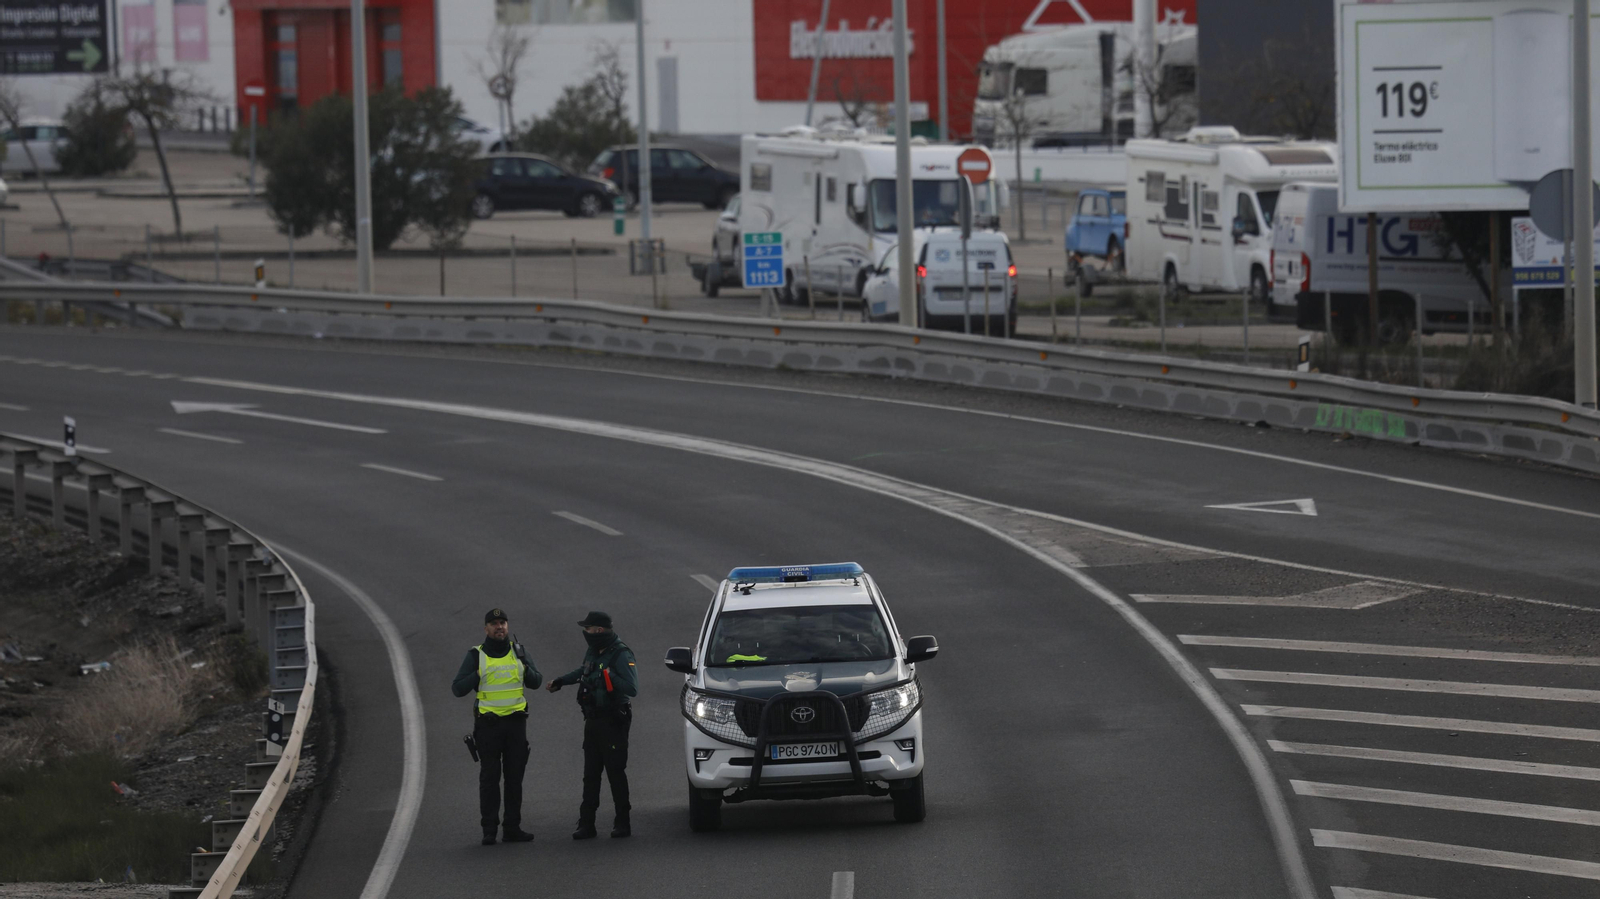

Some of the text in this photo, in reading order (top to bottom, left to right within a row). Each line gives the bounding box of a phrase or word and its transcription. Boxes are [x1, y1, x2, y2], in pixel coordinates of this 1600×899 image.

[60, 4, 99, 25] Digital
[1374, 141, 1438, 151] Termo eléctrico
[755, 247, 773, 256] A-7
[757, 261, 770, 269] km
[750, 270, 779, 284] 1113
